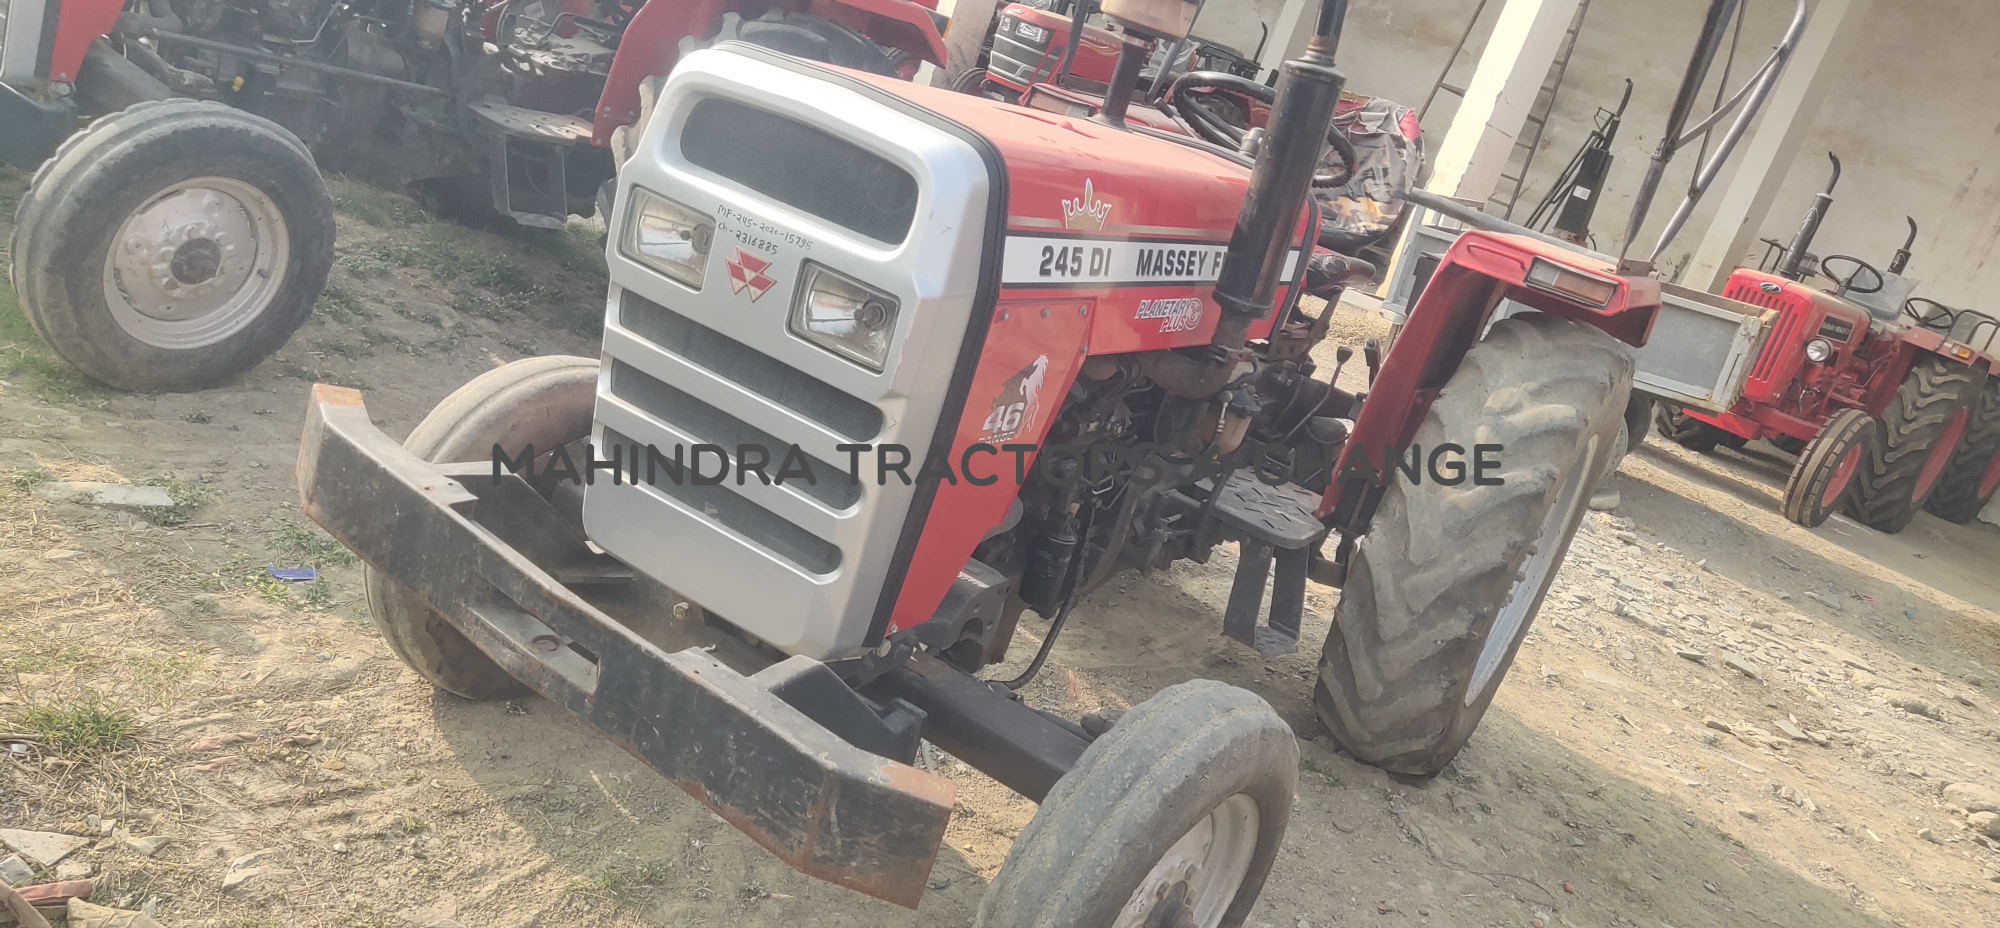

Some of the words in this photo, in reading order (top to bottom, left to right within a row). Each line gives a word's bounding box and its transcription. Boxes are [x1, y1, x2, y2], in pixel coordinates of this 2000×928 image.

[1039, 245, 1084, 278] 245
[1089, 247, 1112, 278] DI
[1136, 248, 1208, 277] MASSEY
[1135, 298, 1193, 319] PLANETARY
[1159, 314, 1187, 333] PLUS
[982, 402, 1025, 433] 46
